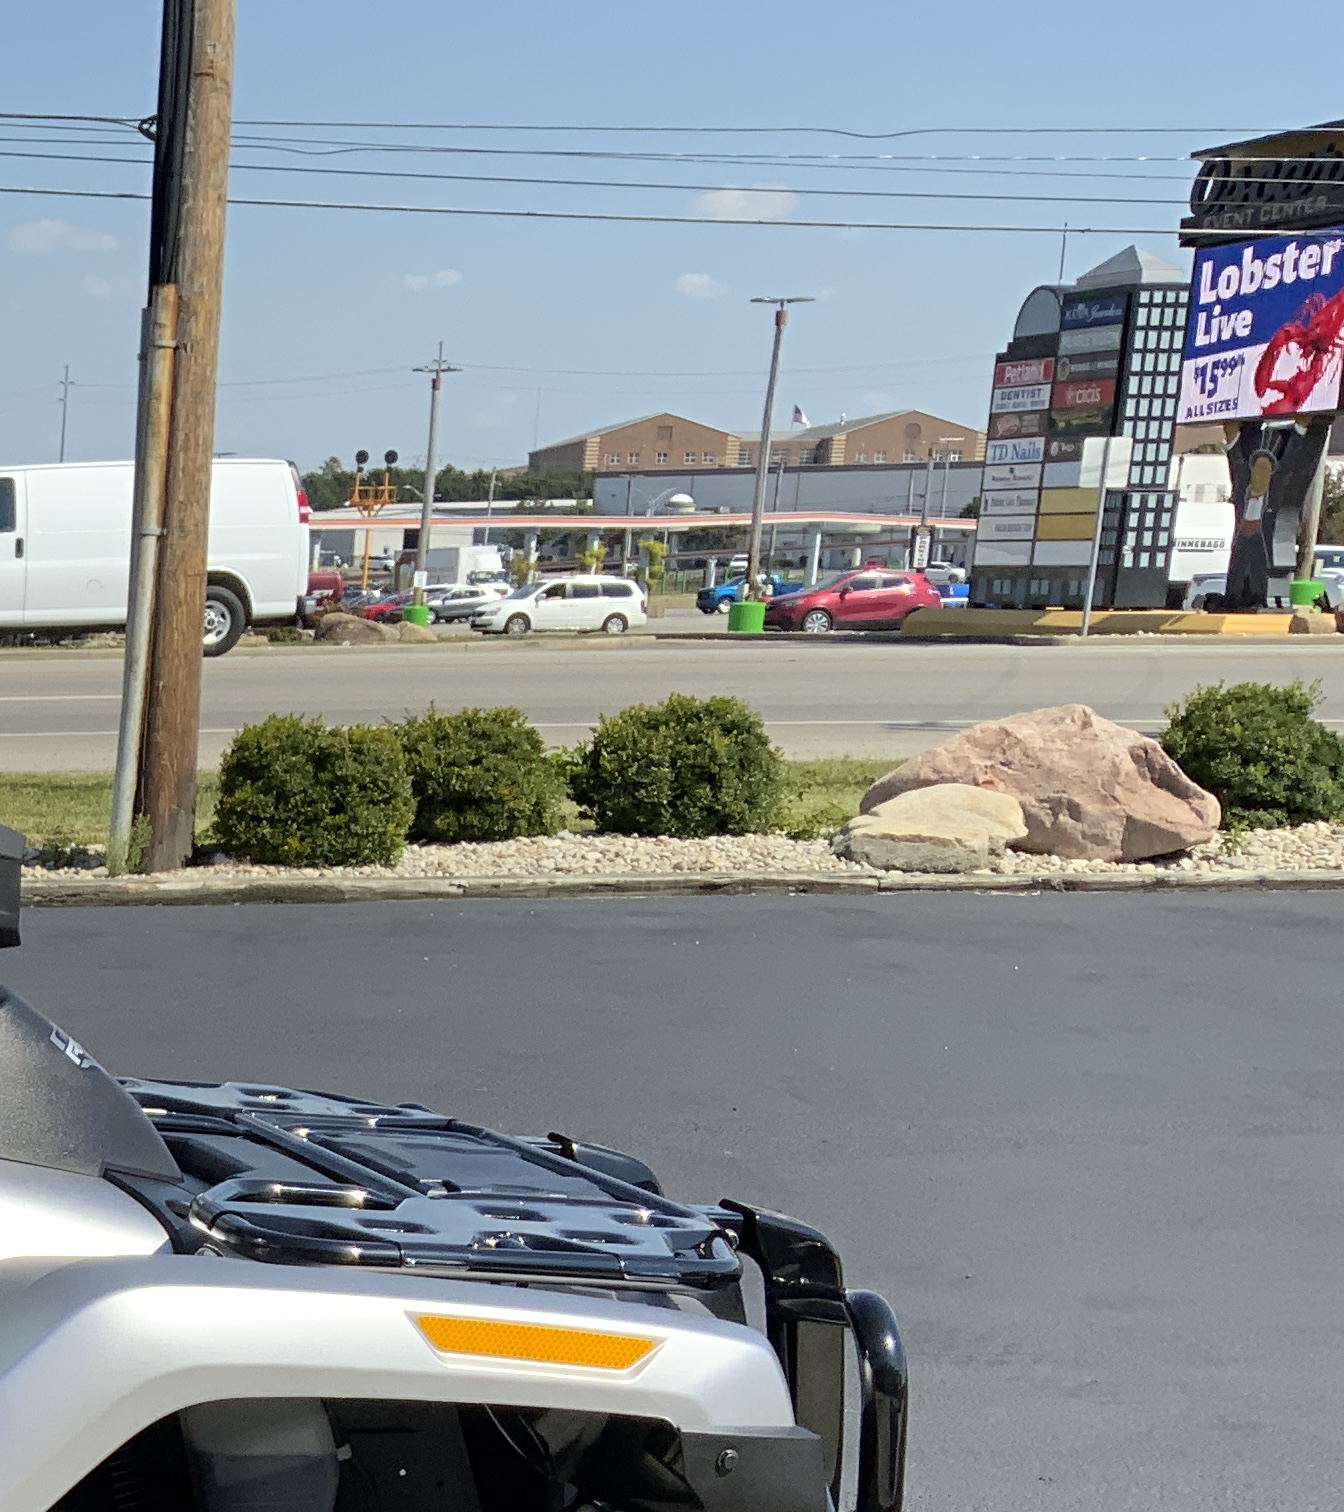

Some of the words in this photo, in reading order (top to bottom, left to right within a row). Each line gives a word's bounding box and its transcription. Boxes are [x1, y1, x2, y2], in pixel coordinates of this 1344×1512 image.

[1260, 195, 1329, 221] CENTER
[1199, 238, 1342, 305] Lobster
[1195, 304, 1253, 346] Live
[1000, 387, 1043, 401] DENTIST
[990, 444, 1009, 461] TD
[1011, 441, 1042, 460] Nails
[1175, 540, 1226, 549] INNEBAGO
